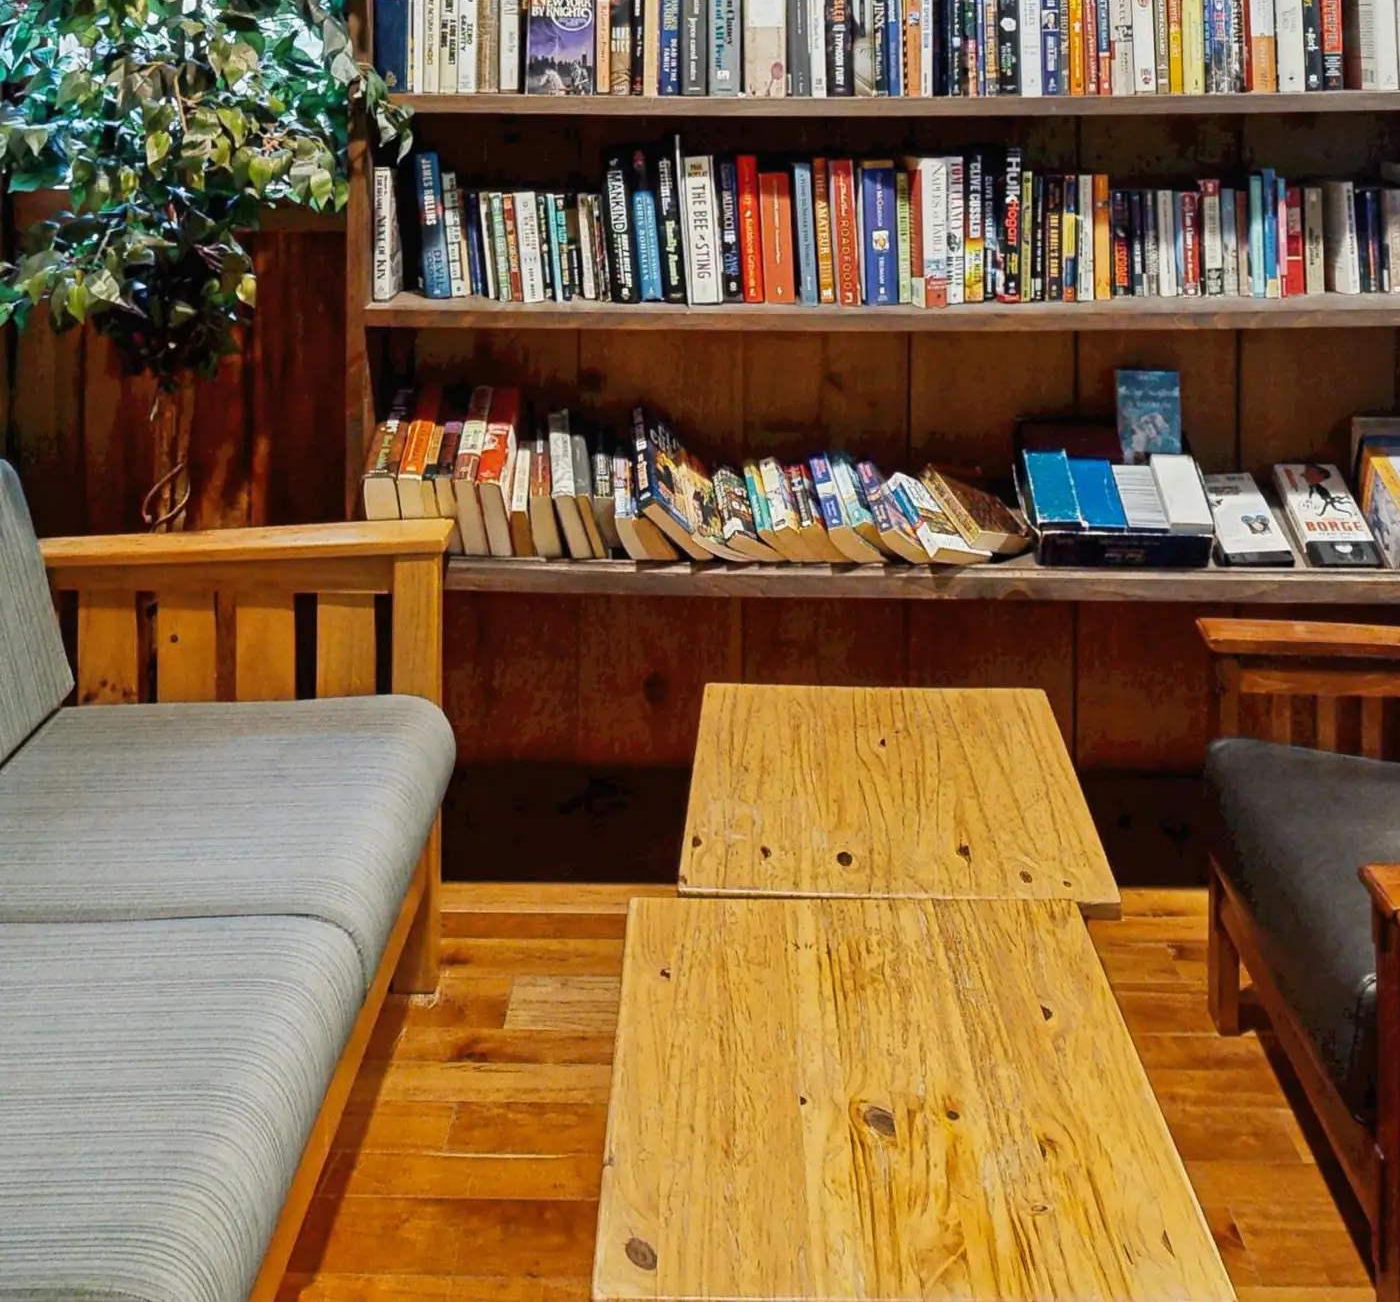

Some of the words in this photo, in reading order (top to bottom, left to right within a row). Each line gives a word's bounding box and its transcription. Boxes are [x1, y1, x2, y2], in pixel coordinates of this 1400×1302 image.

[531, 7, 545, 17] BY
[715, 9, 724, 19] of
[725, 9, 734, 46] Clancy
[873, 0, 884, 28] JINX
[1232, 10, 1243, 43] RYAN
[715, 23, 723, 39] All
[835, 33, 844, 66] TYPHOON
[835, 67, 844, 85] FURY
[420, 158, 433, 187] JAMES
[931, 164, 943, 207] NAPLES
[950, 162, 961, 185] TOM
[969, 162, 980, 190] CLIVE
[1004, 156, 1021, 203] Hulk
[607, 170, 627, 232] MANKIND
[691, 184, 706, 205] THE
[722, 190, 735, 229] BALDACCI
[635, 197, 644, 225] CHRIS
[693, 210, 708, 230] BEE
[817, 199, 829, 254] AMATEUR
[969, 193, 981, 238] CUSSLER
[1004, 202, 1019, 246] Hogan
[932, 222, 944, 255] TABLE
[376, 259, 387, 279] KIN
[695, 243, 710, 279] STING
[840, 220, 852, 289] ROADFOOD
[1305, 521, 1364, 532] BORGE
